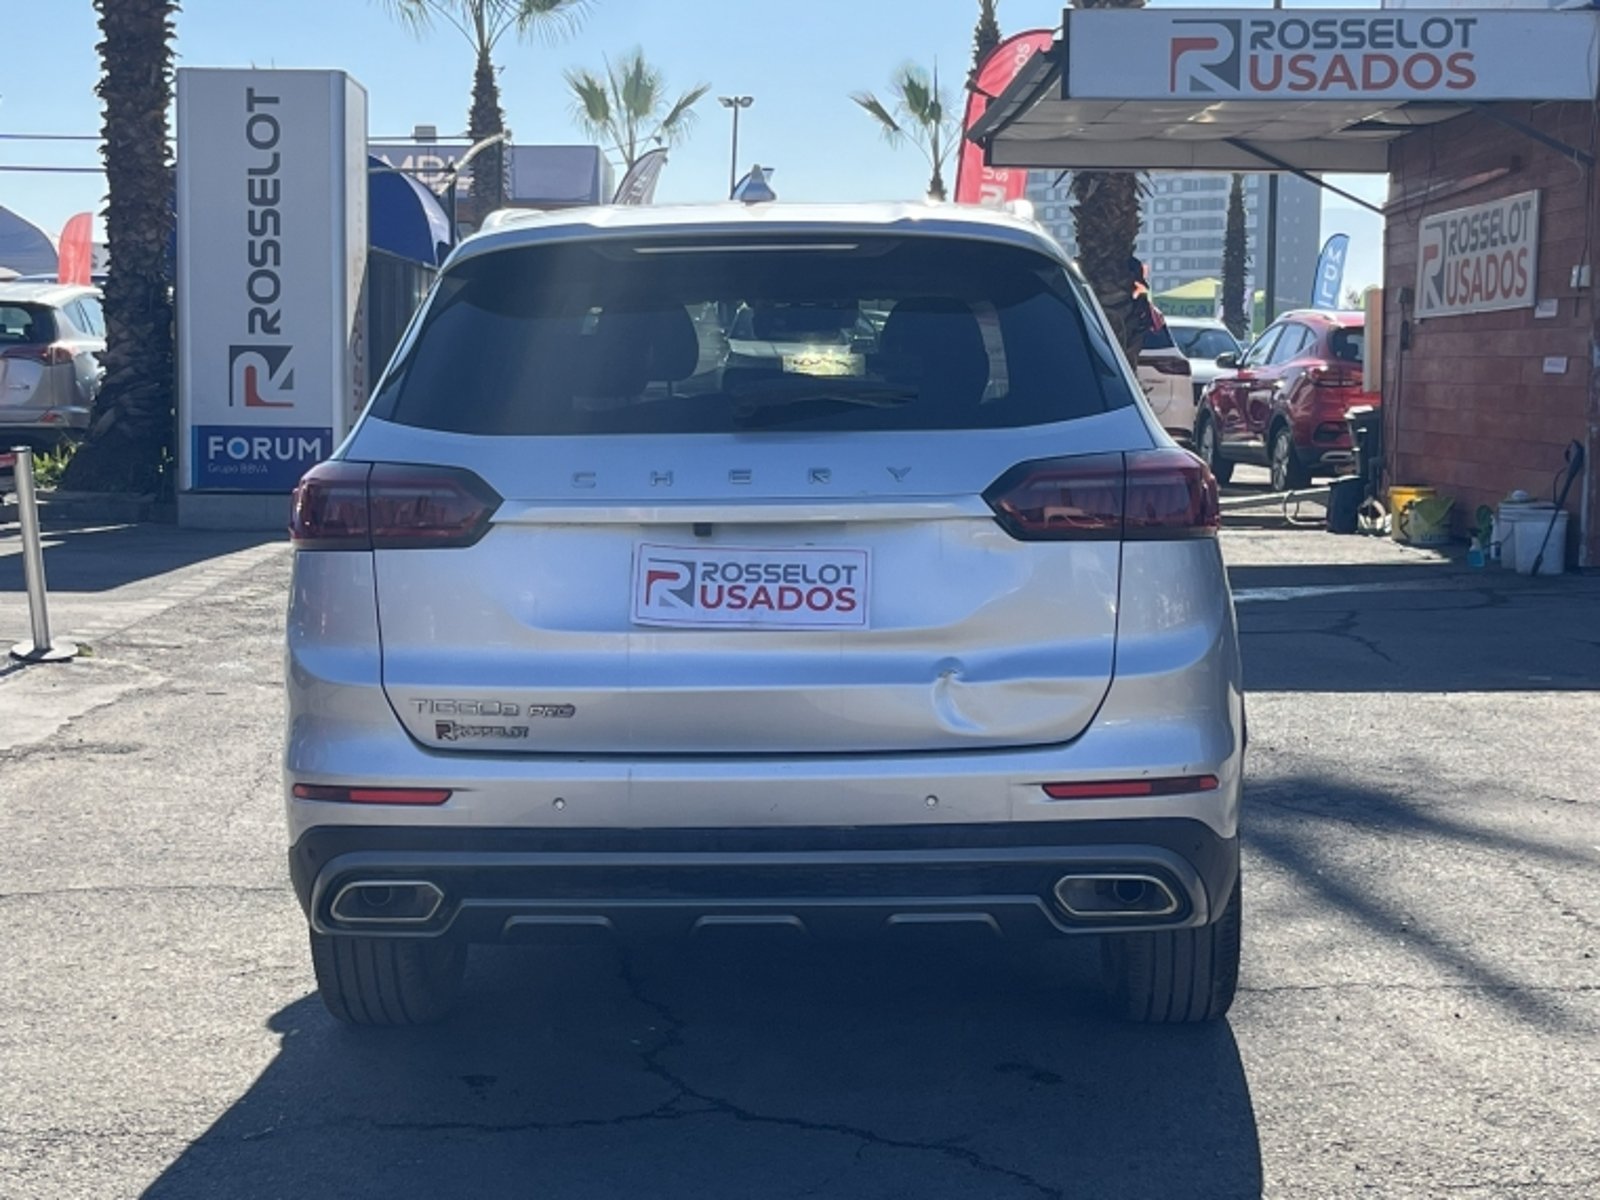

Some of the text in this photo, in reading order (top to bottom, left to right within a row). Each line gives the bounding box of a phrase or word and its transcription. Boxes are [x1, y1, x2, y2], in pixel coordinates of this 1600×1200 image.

[1249, 17, 1478, 50] ROSSELOT
[1249, 52, 1477, 91] USADOS
[246, 87, 281, 335] ROSSELOT
[1448, 201, 1531, 255] ROSSELOT
[1446, 247, 1528, 305] USADOS
[208, 436, 321, 460] FORUM
[208, 463, 239, 474] Grupo
[571, 466, 912, 488] CHERY
[701, 562, 858, 585] ROSSELOT
[700, 585, 857, 612] USADOS
